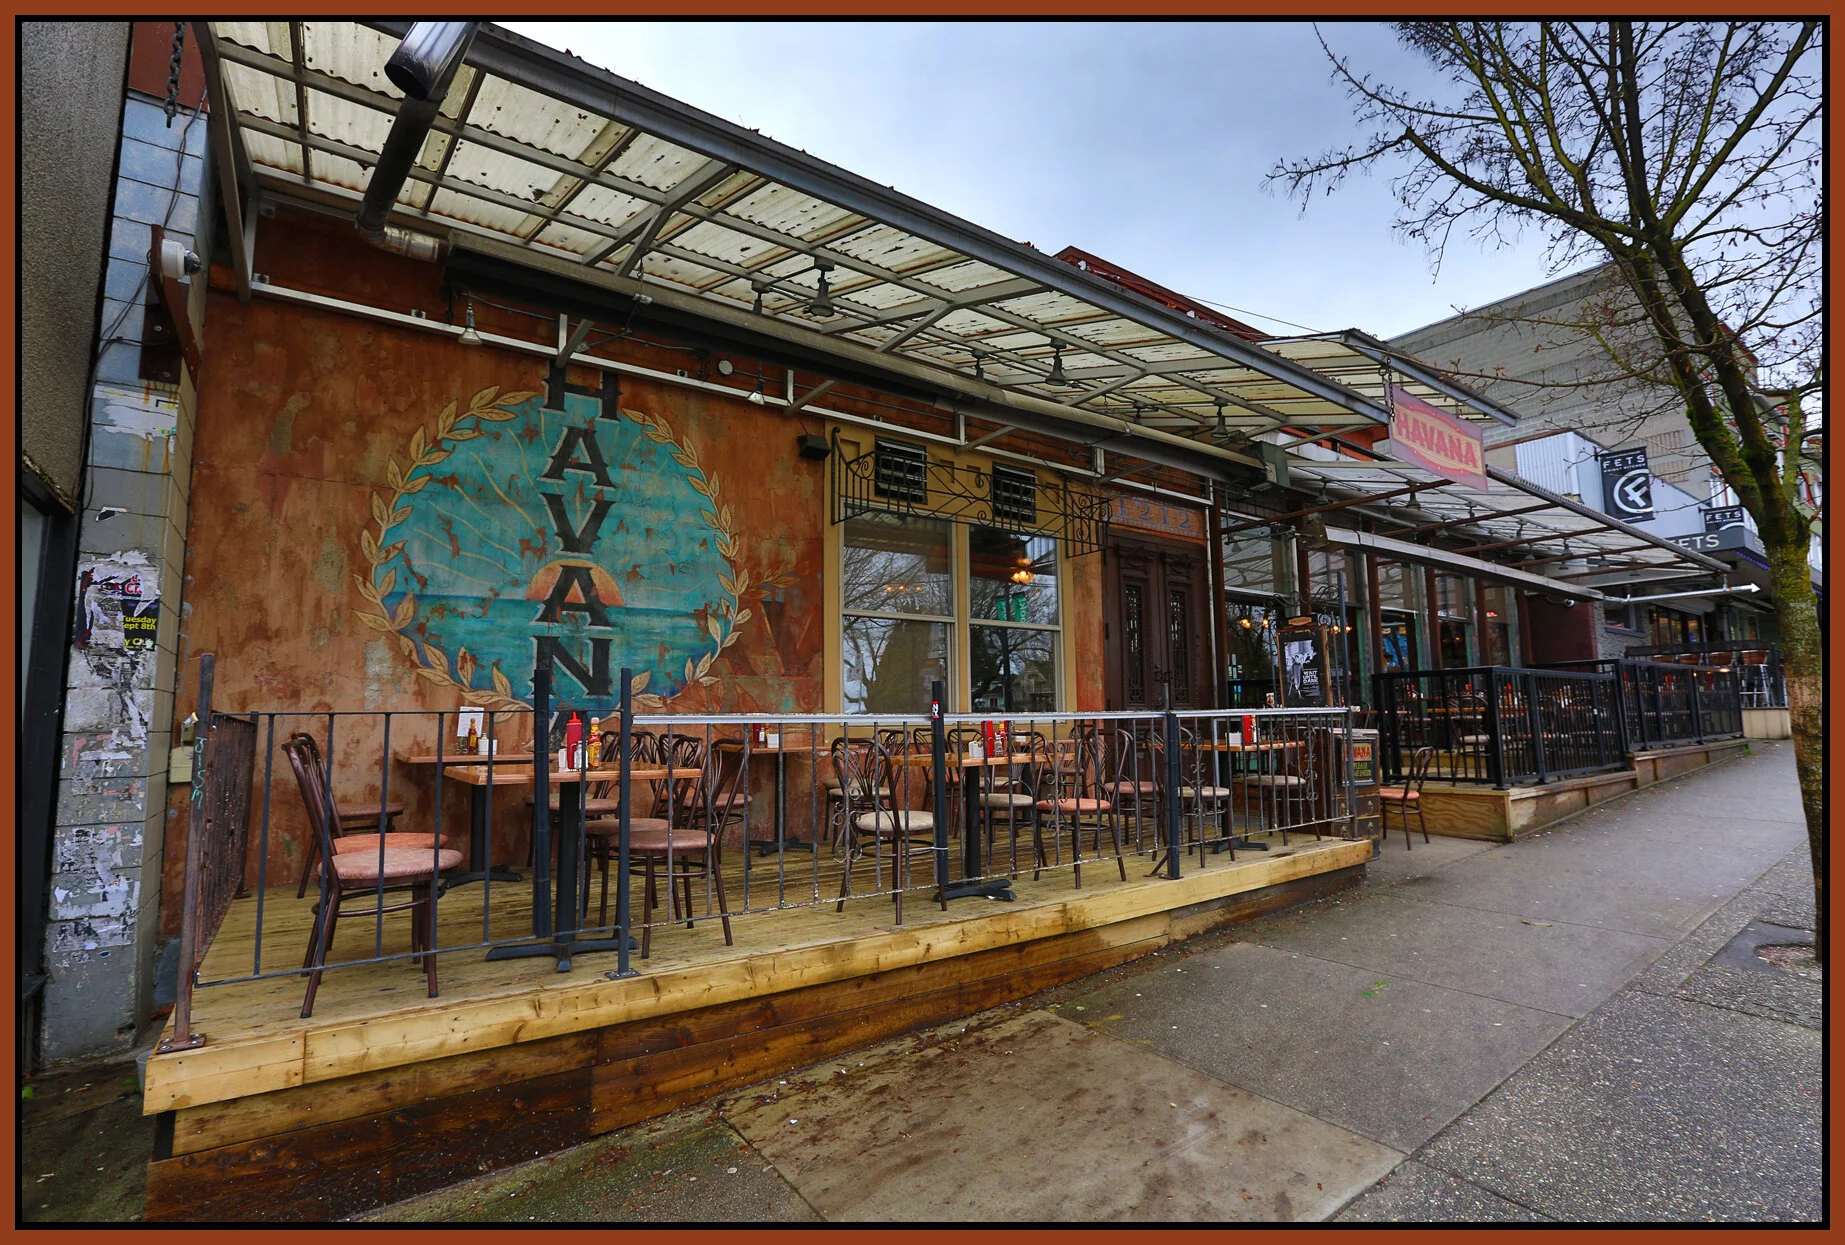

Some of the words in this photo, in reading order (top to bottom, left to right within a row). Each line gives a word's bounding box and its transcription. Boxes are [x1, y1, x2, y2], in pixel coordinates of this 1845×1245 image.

[1395, 406, 1479, 469] HAVANA
[1603, 454, 1646, 469] FETS
[1117, 498, 1192, 529] 1212
[1705, 510, 1742, 521] FETS
[1668, 534, 1720, 551] ETS
[122, 615, 157, 625] Tuesday
[123, 622, 140, 631] ept
[140, 622, 156, 631] 8th
